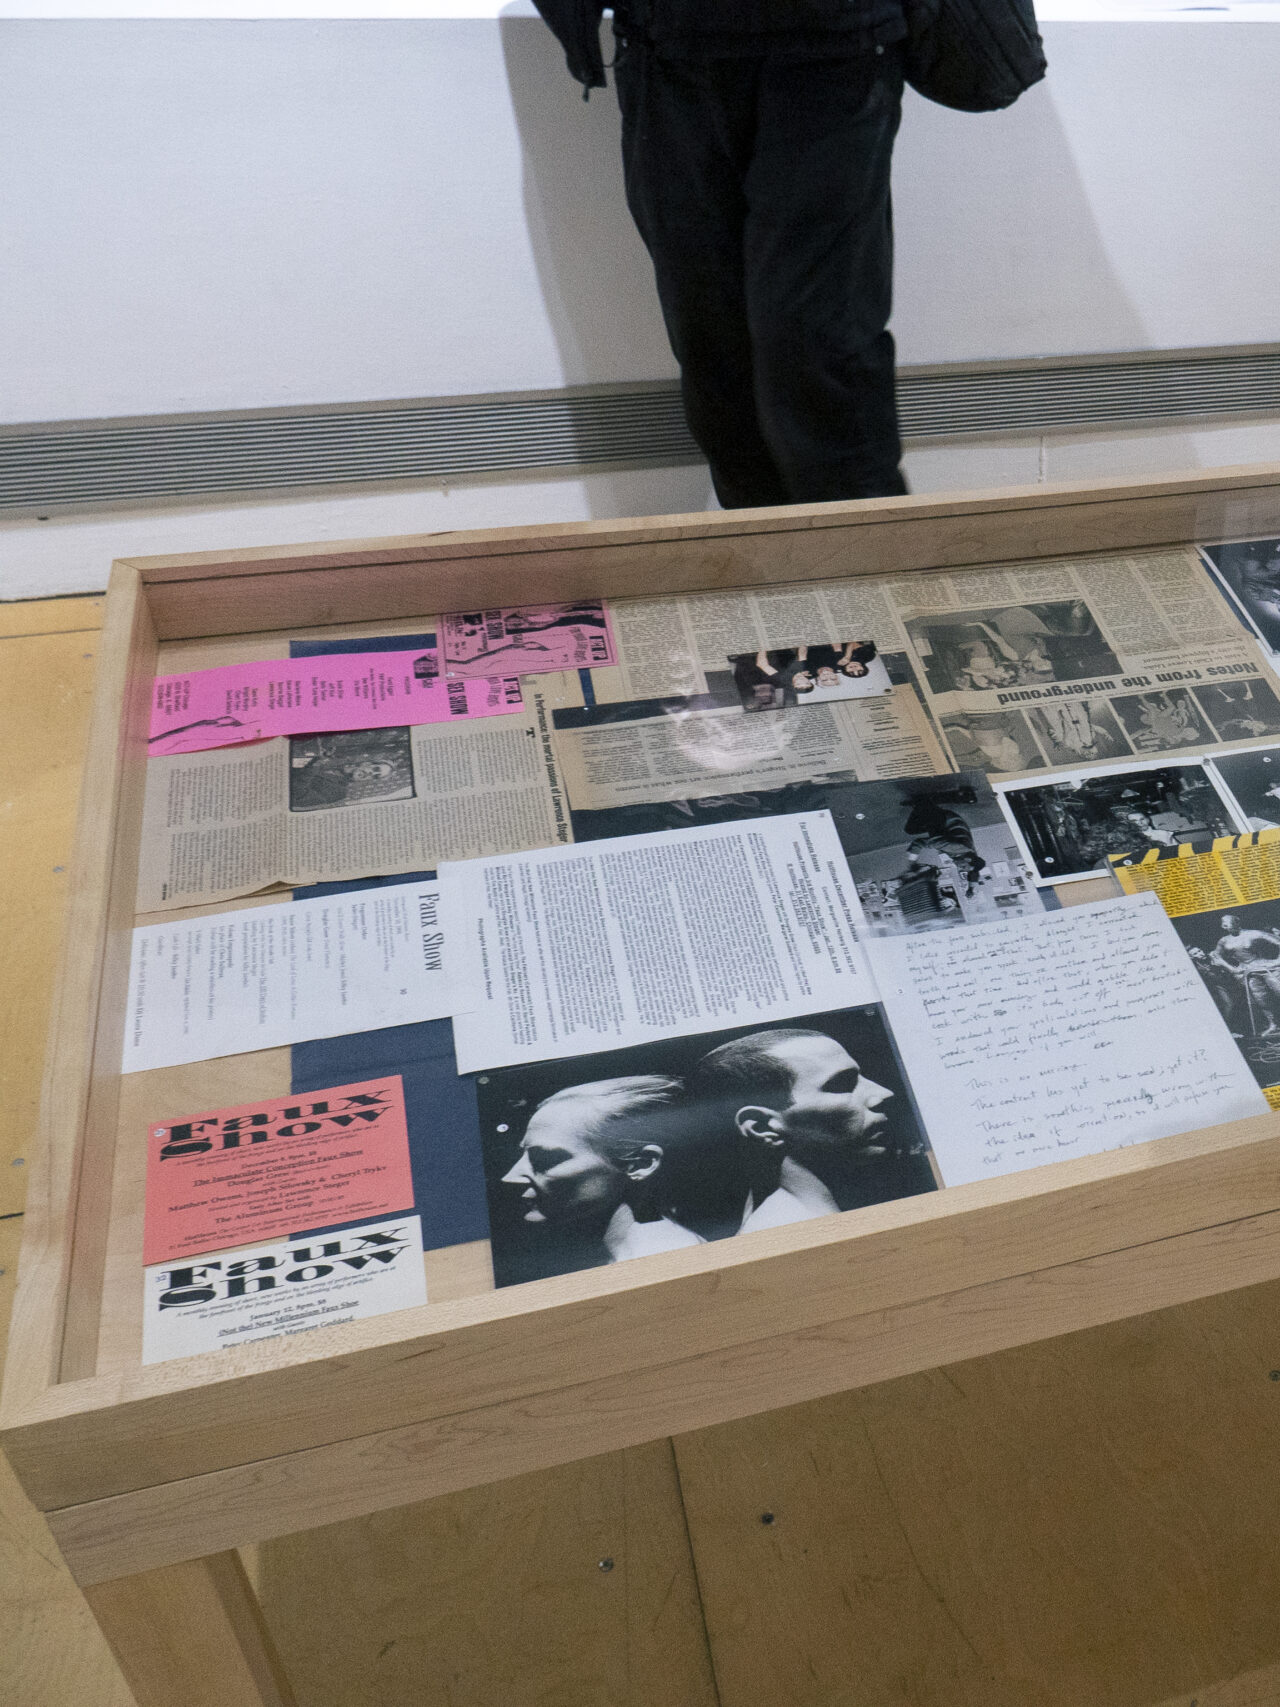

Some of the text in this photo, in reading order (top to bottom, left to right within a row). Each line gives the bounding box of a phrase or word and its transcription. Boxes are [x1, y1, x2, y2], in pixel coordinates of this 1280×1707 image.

[485, 611, 503, 640] SEX SHOW
[997, 661, 1258, 705] Notes from the underground
[446, 681, 468, 715] SEX SHOW
[535, 699, 548, 732] Performance:
[543, 744, 555, 762] mortal
[545, 763, 558, 787] passions
[703, 768, 753, 780] performance
[551, 795, 564, 822] Lawrence
[556, 823, 568, 842] Steger
[801, 829, 814, 853] Immediate
[809, 853, 821, 872] Release
[834, 884, 847, 908] December
[842, 908, 853, 922] Press
[418, 892, 444, 970] Faux Show
[477, 917, 486, 946] Photographs
[847, 923, 859, 943] Release
[965, 1077, 993, 1090] This
[970, 1097, 995, 1110] The
[1045, 1086, 1063, 1097] has
[1070, 1076, 1089, 1097] yet
[1097, 1074, 1110, 1083] to
[163, 1089, 391, 1144] Faux
[975, 1120, 1015, 1132] There
[160, 1106, 394, 1161] Show
[984, 1135, 1006, 1147] the
[1014, 1131, 1036, 1141] idea
[193, 1178, 209, 1187] The
[211, 1168, 263, 1184] Immaculate
[265, 1158, 315, 1173] Conception
[317, 1154, 337, 1163] Faux
[339, 1149, 363, 1159] Show
[241, 1158, 277, 1169] December
[168, 1200, 208, 1211] Matthew
[246, 1186, 276, 1197] Joseph
[279, 1179, 316, 1190] Silovsky
[330, 1169, 360, 1180] Cheryl
[227, 1176, 263, 1187] Douglas
[279, 1180, 350, 1198] Lawrence Steger
[235, 1207, 283, 1220] Aluminum
[284, 1200, 313, 1210] Group
[160, 1227, 408, 1290] Faux
[158, 1245, 411, 1311] Show
[217, 1327, 238, 1337] (Not
[255, 1319, 273, 1328] New
[275, 1309, 319, 1324] Millennium
[321, 1304, 339, 1313] Faux
[249, 1309, 280, 1321] January
